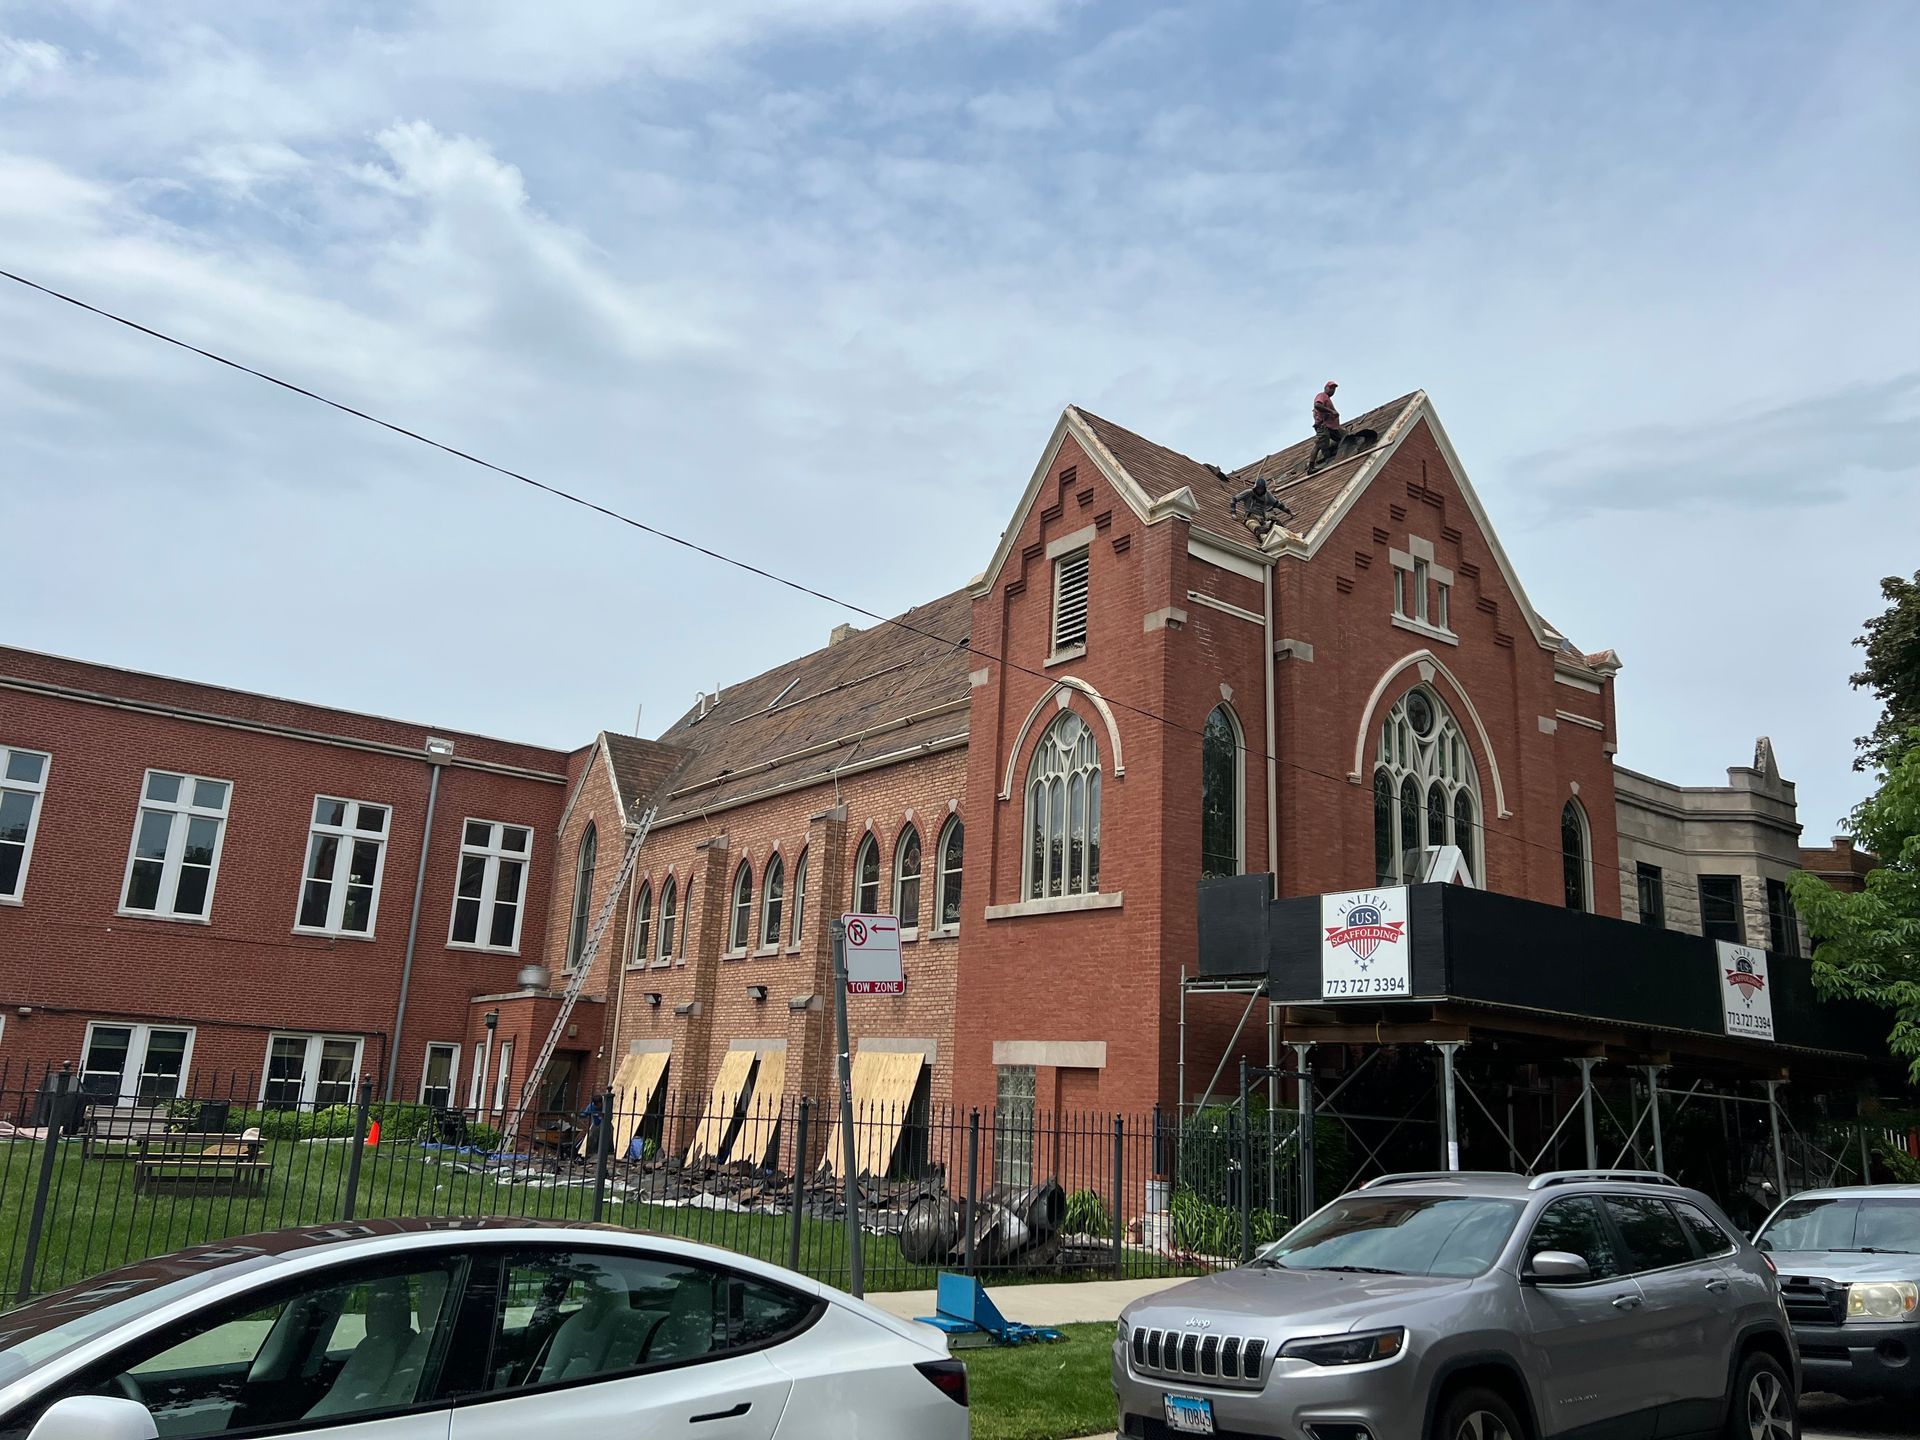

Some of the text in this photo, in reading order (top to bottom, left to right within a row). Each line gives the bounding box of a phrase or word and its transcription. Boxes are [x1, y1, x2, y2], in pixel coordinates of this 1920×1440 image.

[1338, 893, 1388, 914] UNITED
[1356, 912, 1372, 924] US
[1331, 928, 1398, 946] SCAFFOLDING
[850, 982, 900, 993] TOW ZONE
[1326, 976, 1405, 994] 773 727 3394
[1185, 1316, 1211, 1329] Jeep
